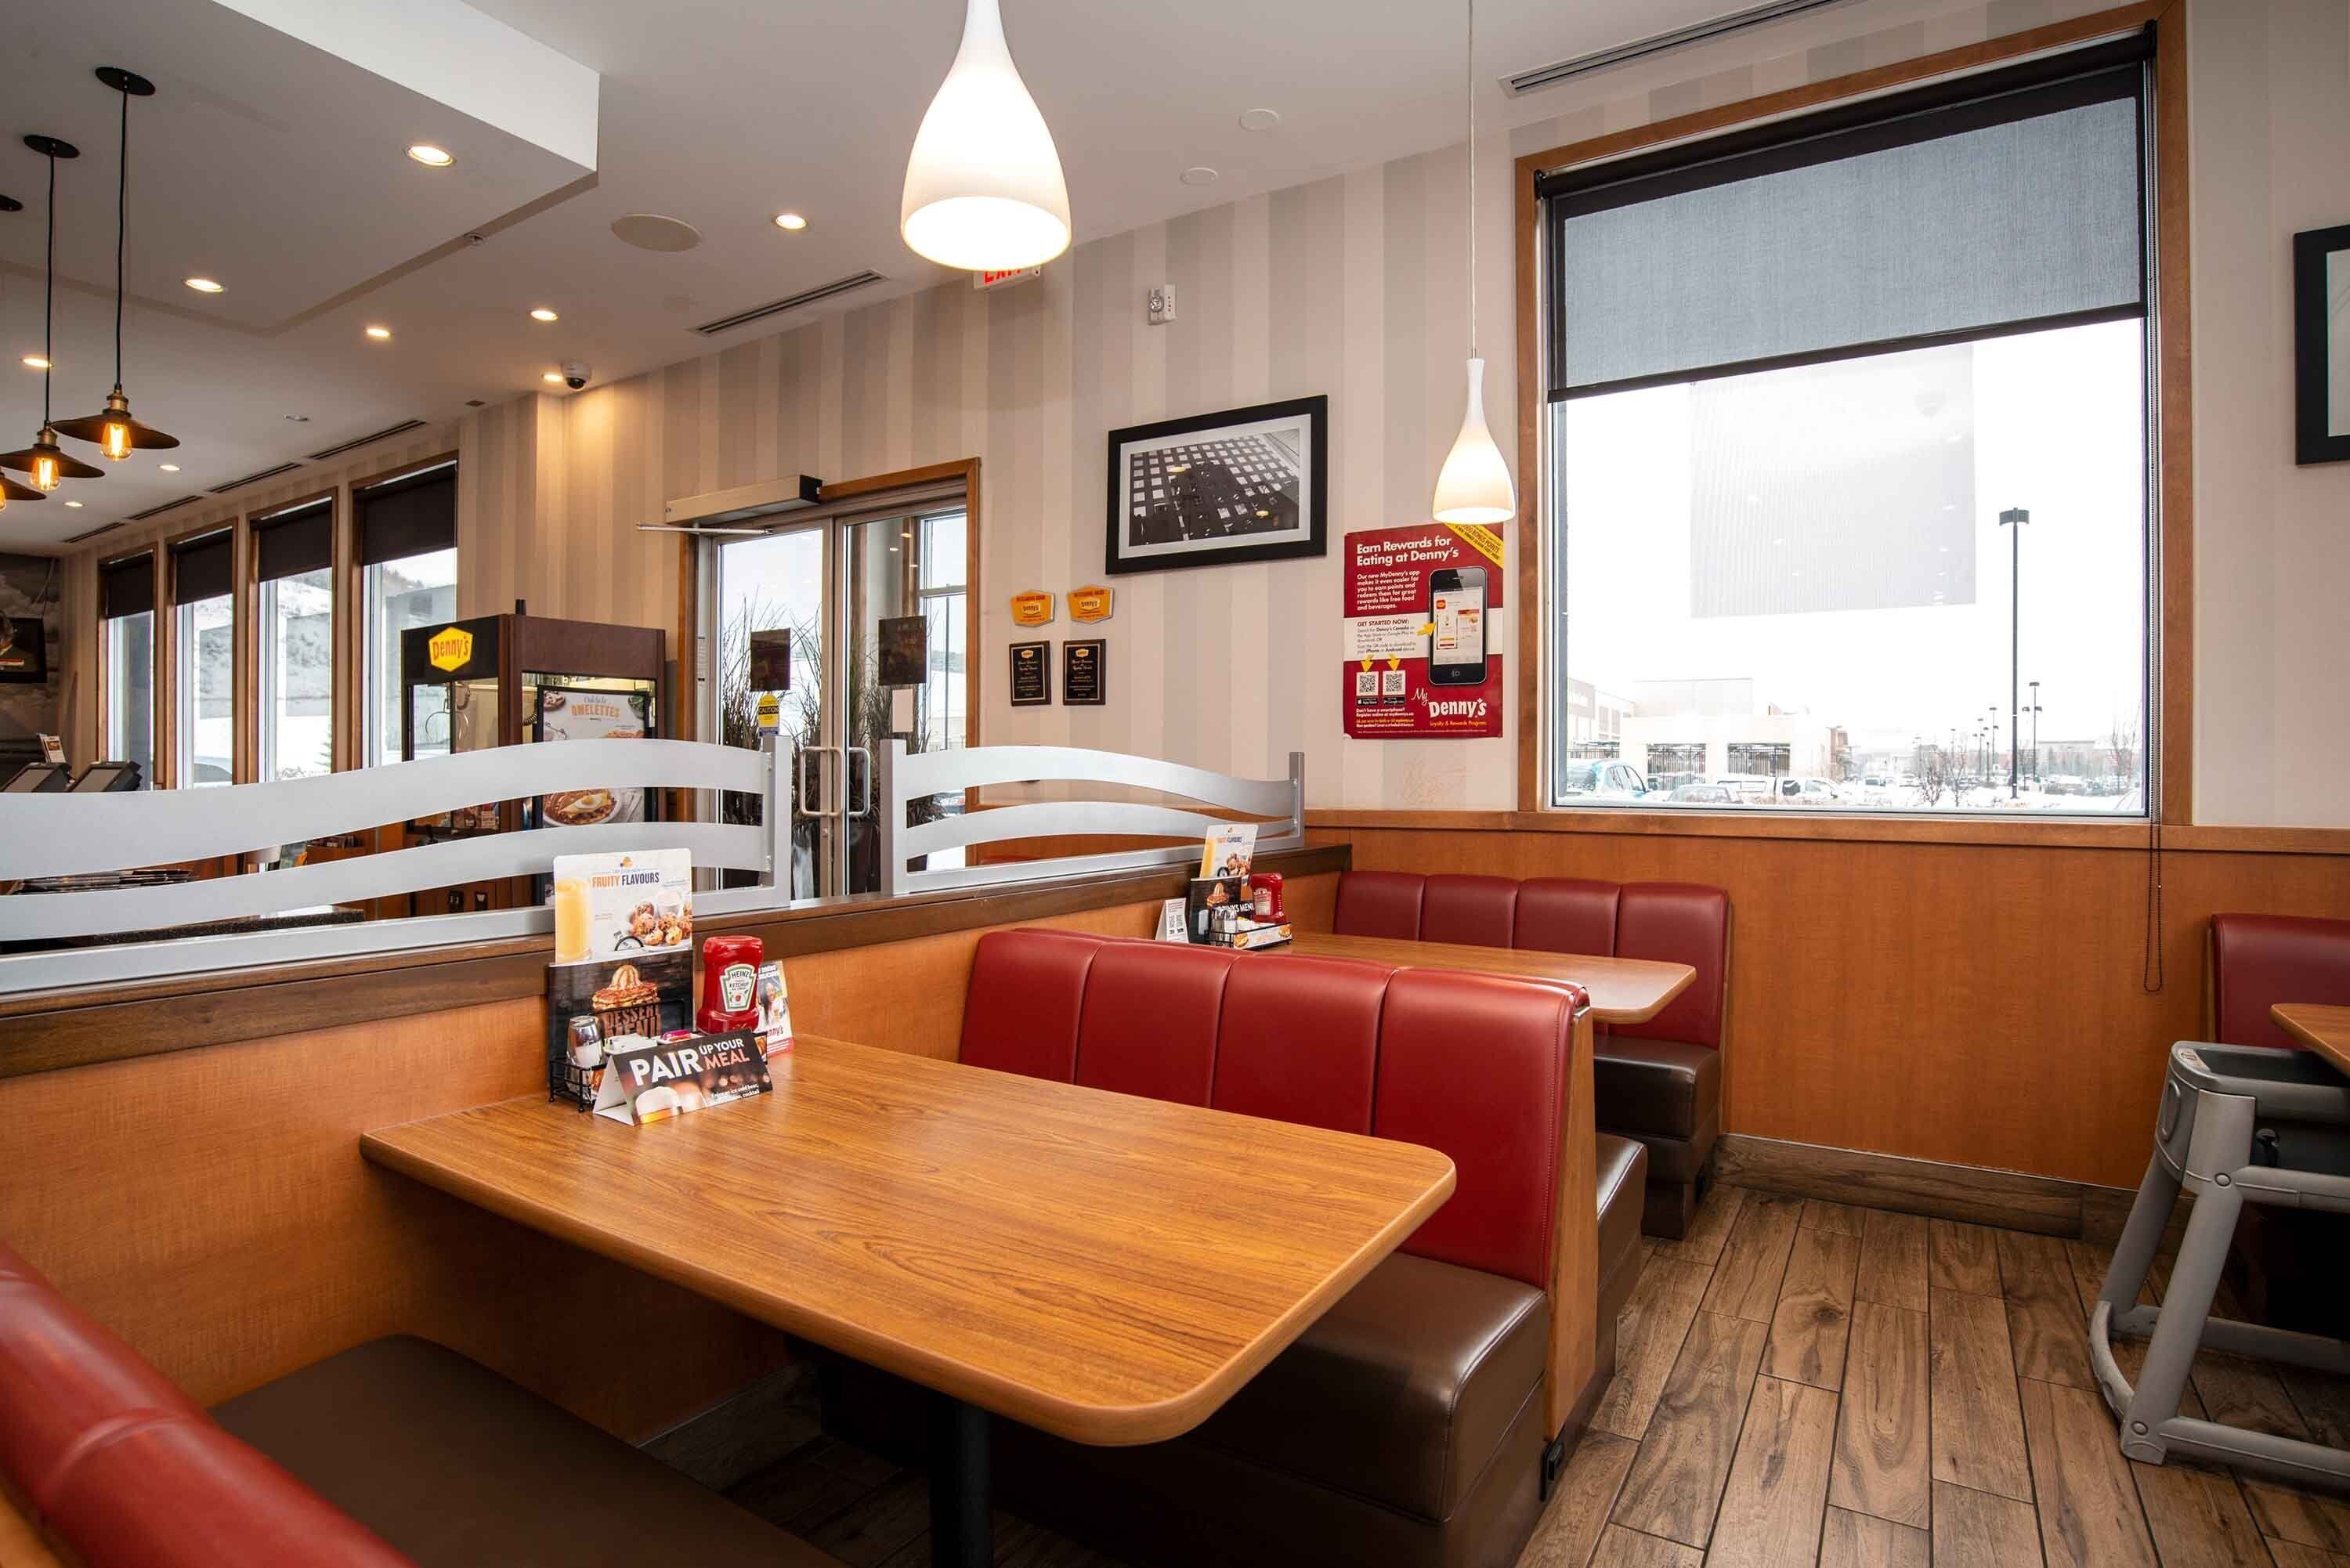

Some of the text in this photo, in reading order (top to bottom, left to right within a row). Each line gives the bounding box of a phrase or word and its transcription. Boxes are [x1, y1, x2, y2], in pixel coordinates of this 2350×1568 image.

[1357, 544, 1381, 555] Earn
[1383, 537, 1432, 551] Rewards
[1434, 535, 1452, 547] for
[1357, 547, 1459, 566] Eating at Denny's
[432, 635, 470, 660] Denny's
[1411, 688, 1429, 706] My
[571, 704, 620, 718] OMELETTES
[1429, 698, 1488, 718] Denny's
[591, 876, 620, 888] FRUITY
[622, 873, 660, 886] FLAVOURS
[629, 1039, 744, 1086] PAIR UP YOUR
[705, 1049, 750, 1071] MEAL
[742, 1089, 760, 1097] cocktail
